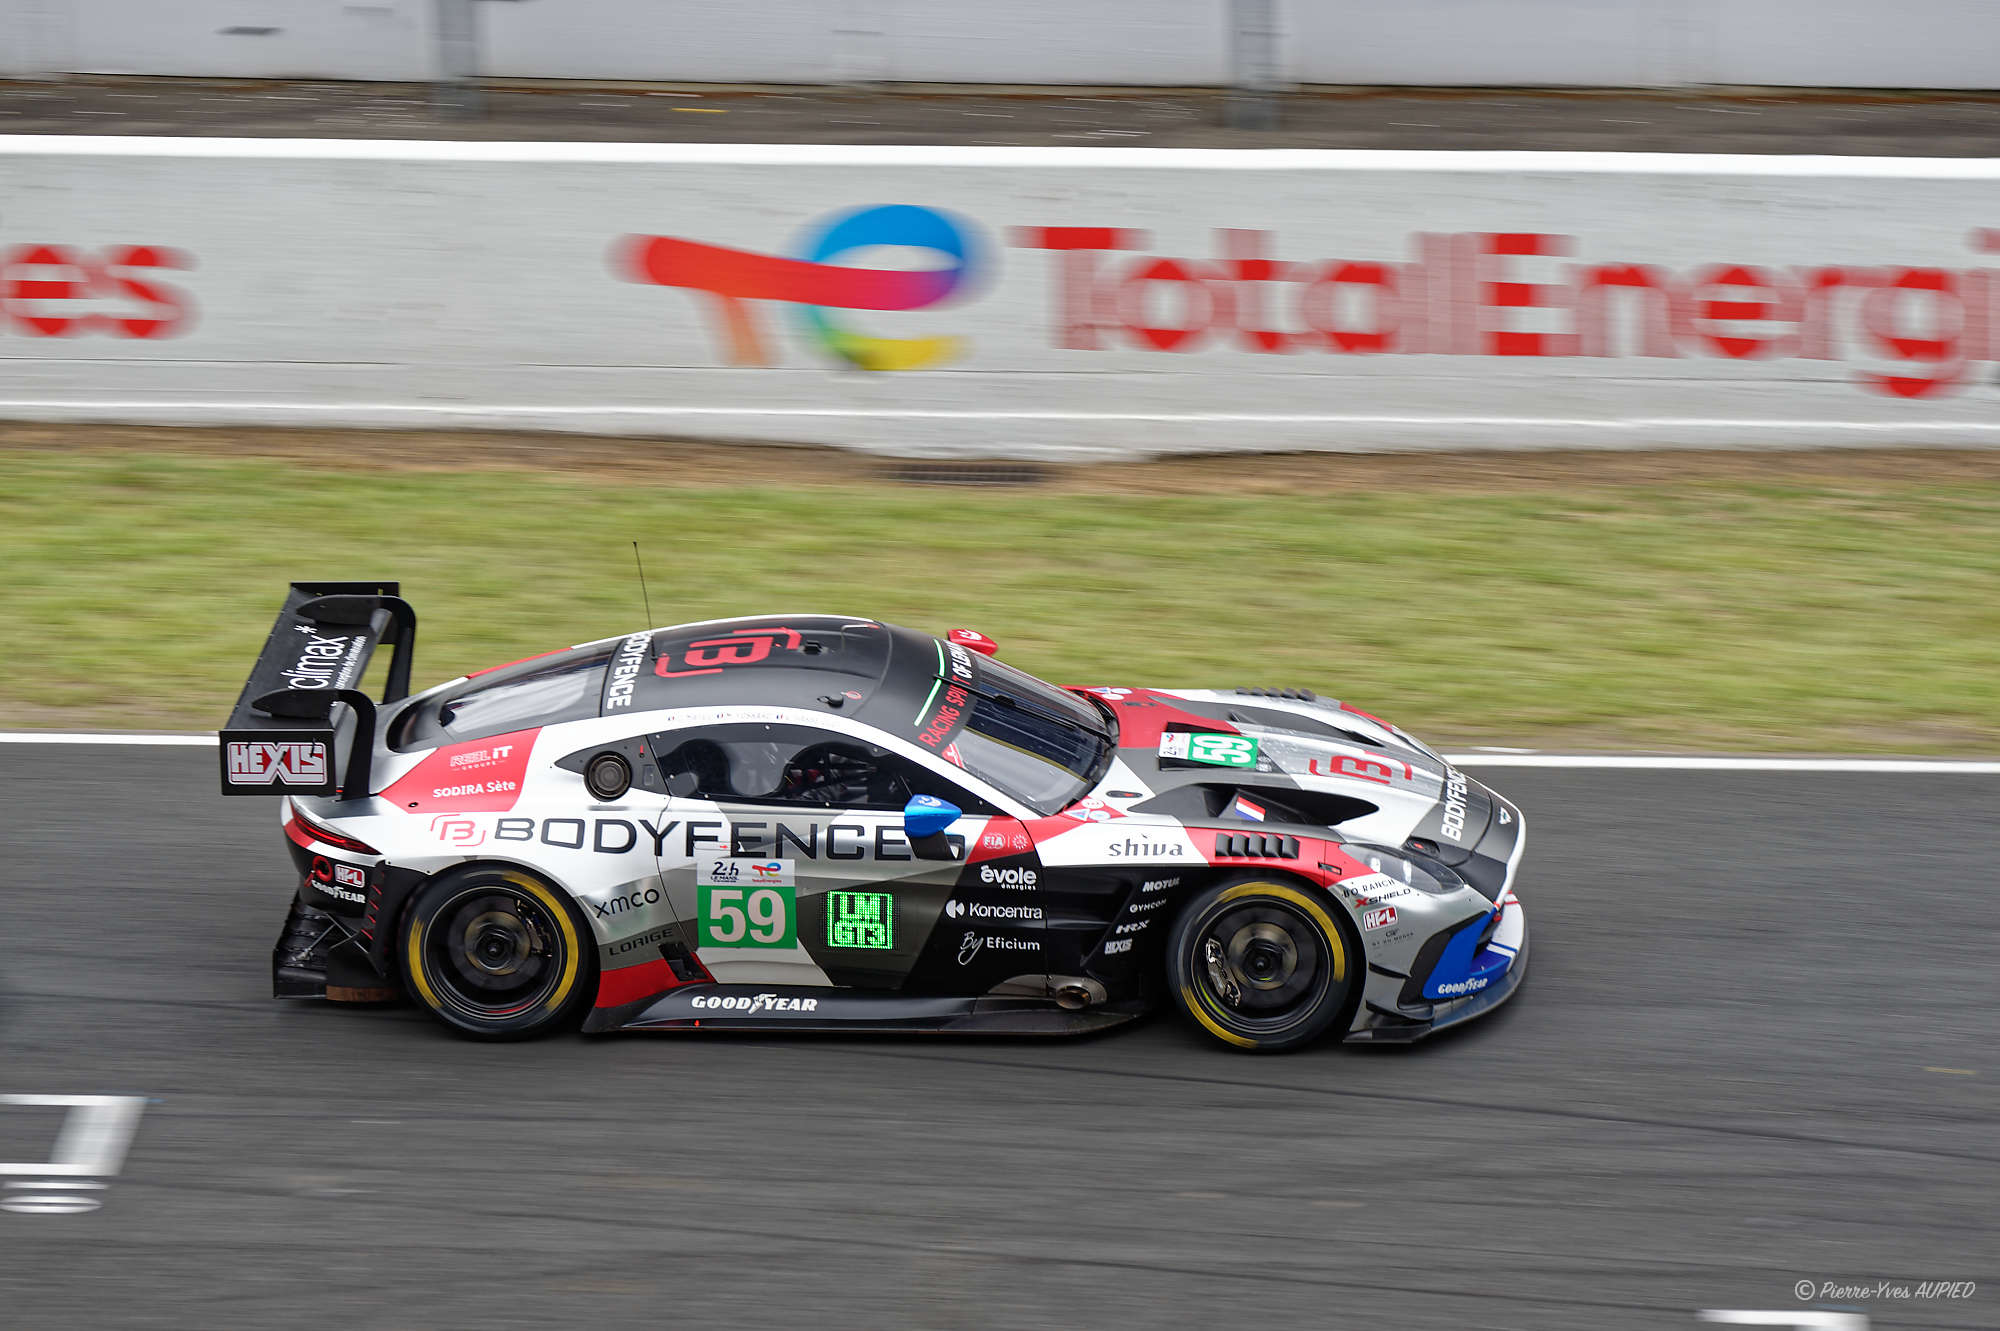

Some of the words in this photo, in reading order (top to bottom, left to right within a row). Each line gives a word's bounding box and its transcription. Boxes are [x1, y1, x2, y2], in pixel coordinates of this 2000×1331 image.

[919, 705, 961, 748] RACING
[952, 659, 973, 679] OF
[228, 743, 326, 784] HEXIS
[1192, 735, 1253, 763] 59
[432, 784, 485, 798] SODIRA
[486, 780, 516, 793] Sète
[494, 817, 912, 861] BODYFENCE
[984, 835, 1004, 848] FIA
[594, 888, 659, 918] xmco
[708, 889, 787, 943] 59
[969, 902, 1043, 920] Koncentra
[609, 928, 675, 957] LORIGE
[958, 931, 984, 966] By
[986, 936, 1041, 951] Eficium
[691, 993, 818, 1014] GOODYEAR
